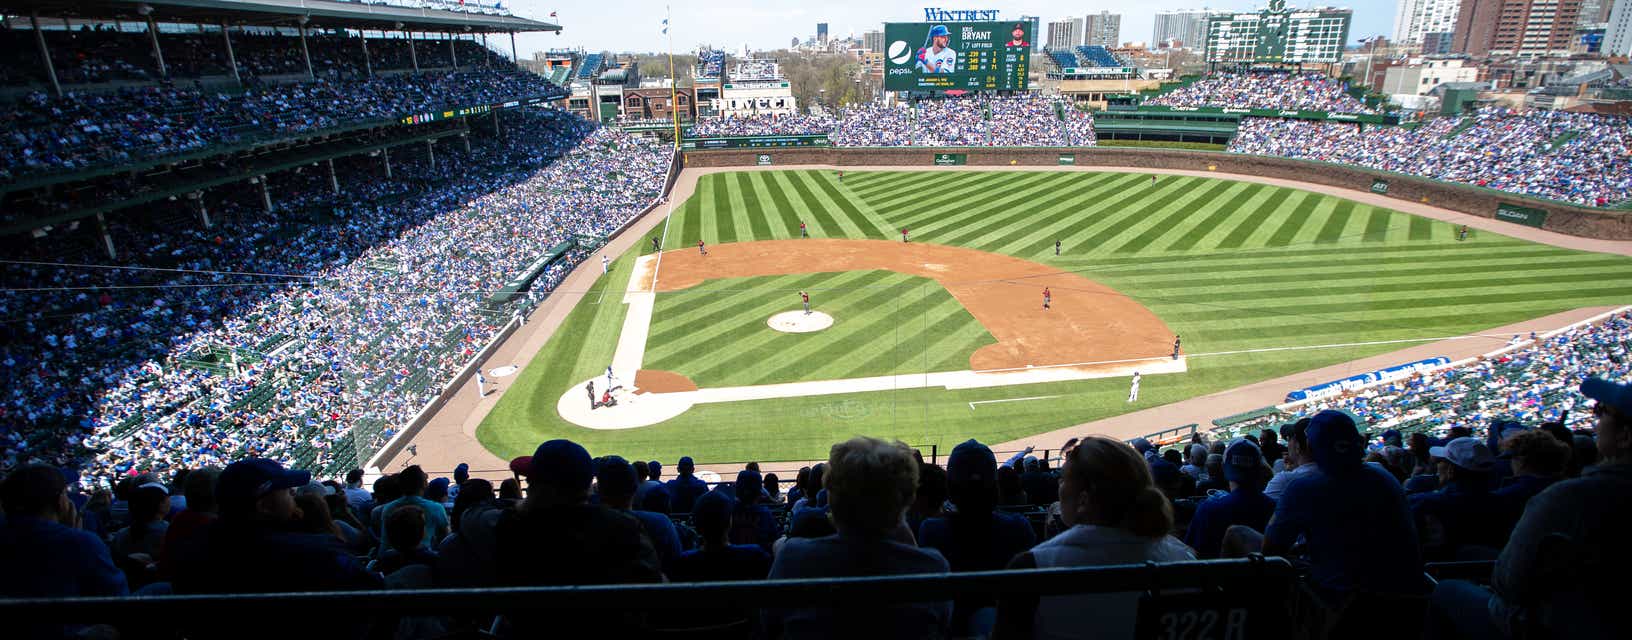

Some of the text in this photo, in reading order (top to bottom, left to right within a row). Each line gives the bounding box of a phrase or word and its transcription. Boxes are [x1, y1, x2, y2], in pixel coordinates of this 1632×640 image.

[961, 31, 992, 40] BRYANT
[889, 68, 911, 76] pepsi
[1498, 208, 1529, 220] SLOAN
